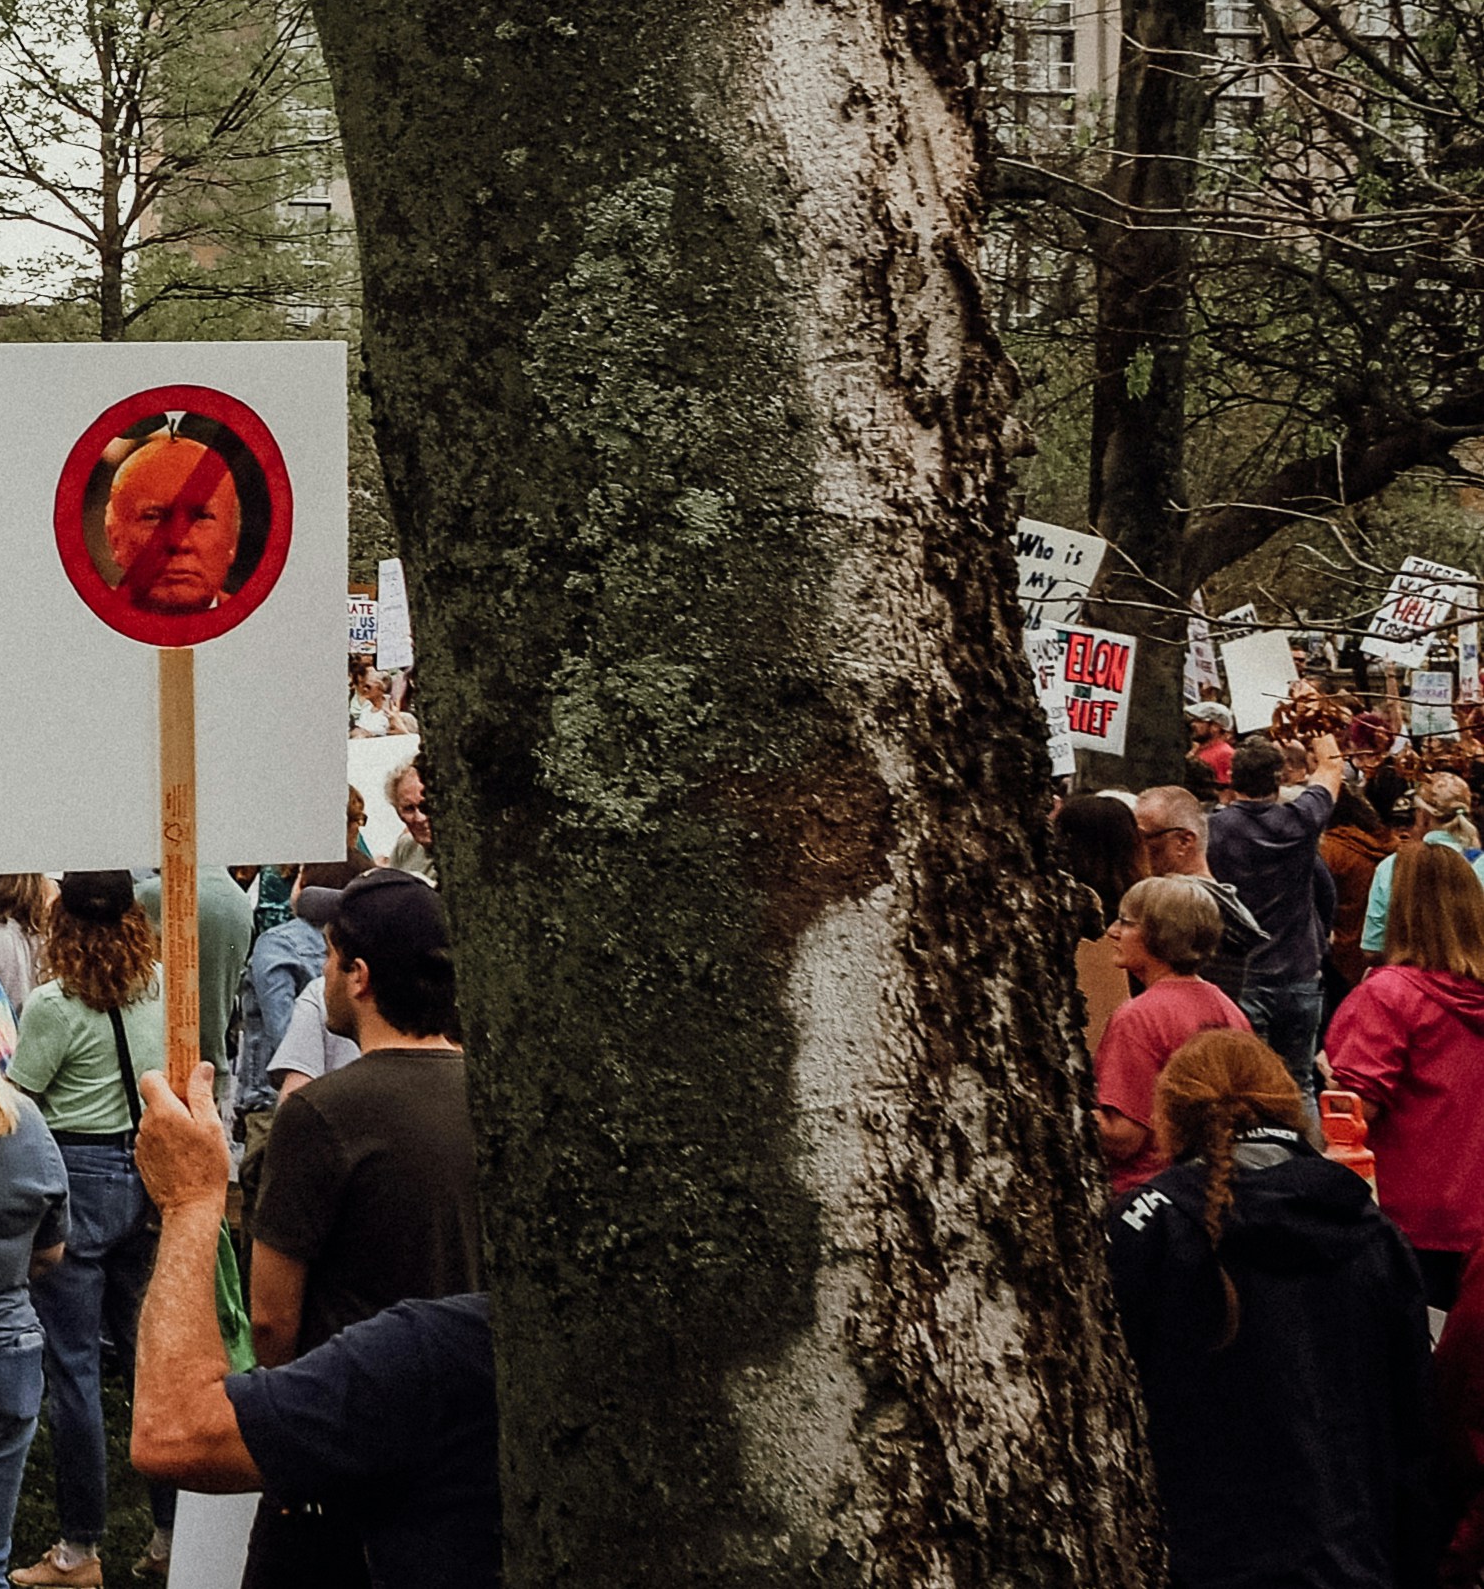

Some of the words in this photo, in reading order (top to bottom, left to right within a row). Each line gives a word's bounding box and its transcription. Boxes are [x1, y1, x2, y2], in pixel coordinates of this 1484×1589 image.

[1017, 531, 1053, 560] Who
[1065, 544, 1083, 566] is
[1065, 631, 1129, 694] ELON
[1066, 696, 1119, 739] HIEF
